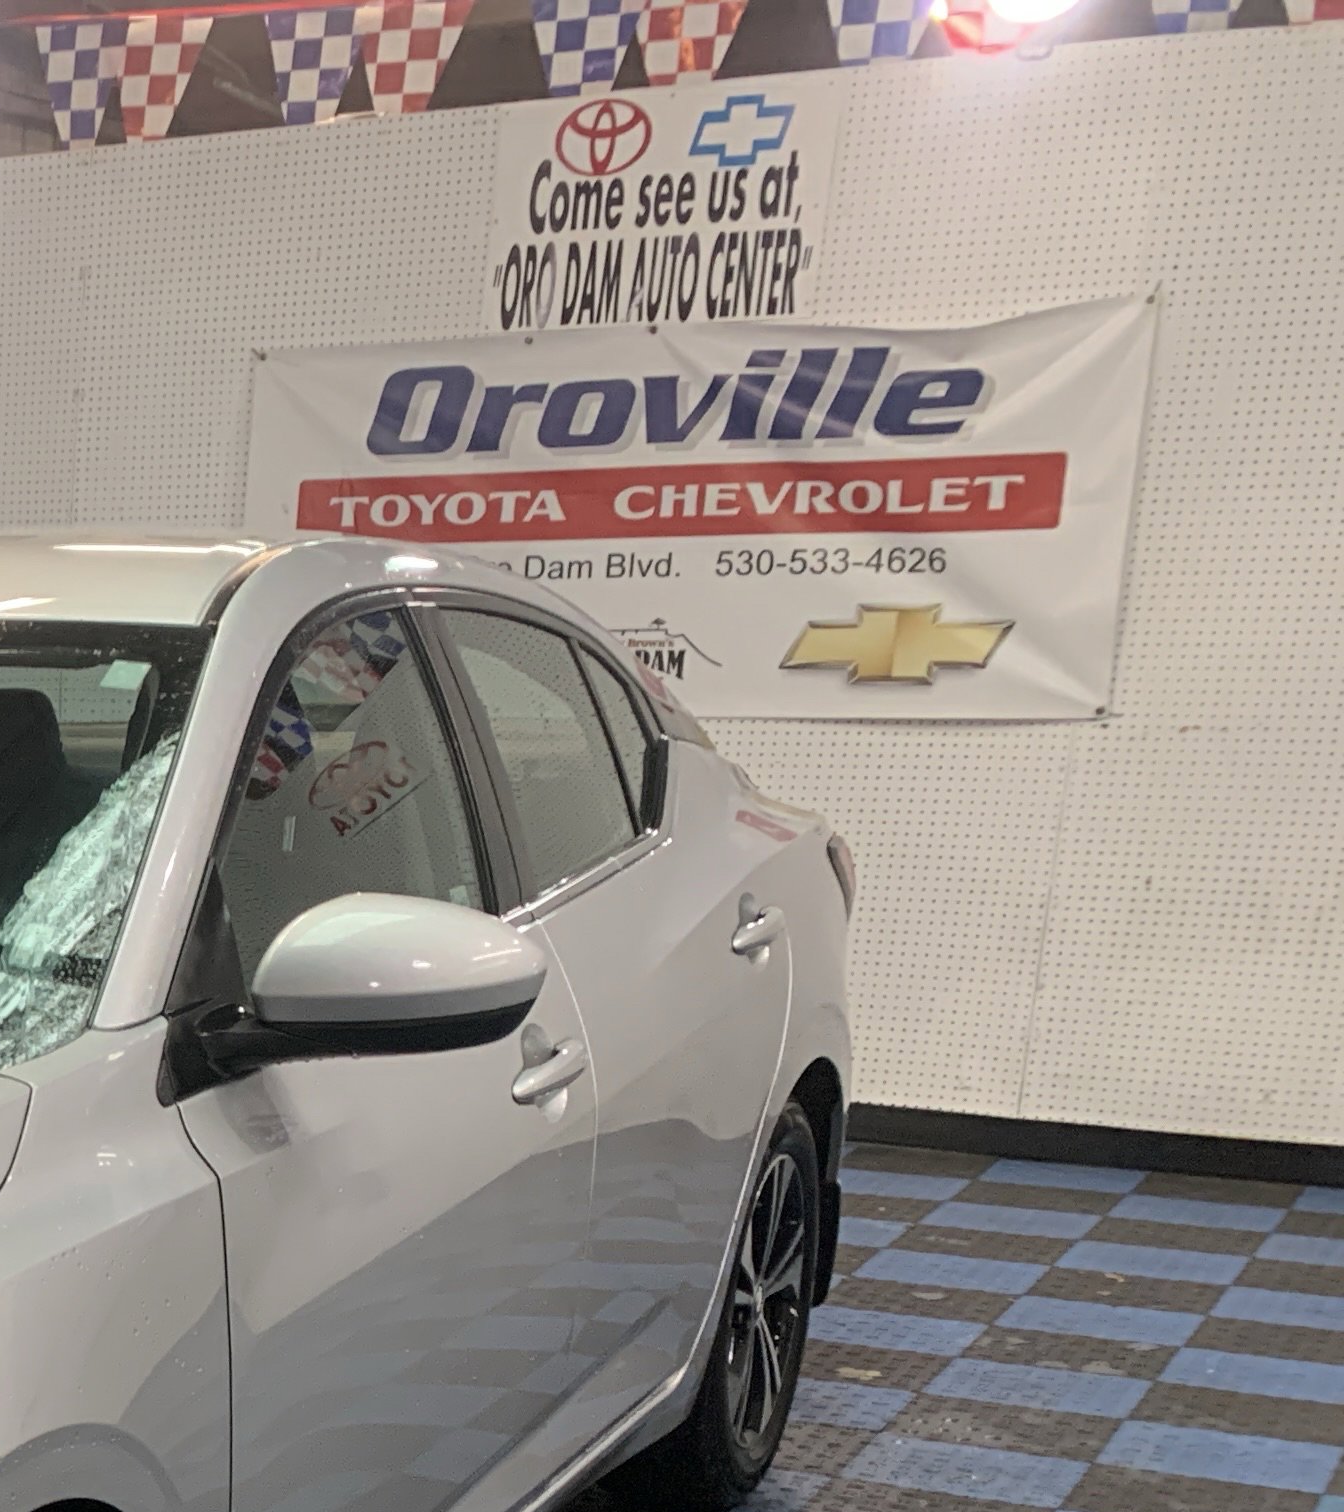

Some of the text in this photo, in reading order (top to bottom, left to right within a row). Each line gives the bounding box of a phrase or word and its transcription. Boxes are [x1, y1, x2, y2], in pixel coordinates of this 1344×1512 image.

[529, 150, 802, 235] Come see us at,
[560, 239, 624, 326] DAM
[626, 232, 700, 323] AUTO
[706, 227, 814, 320] CENTER"
[367, 346, 990, 458] Oroville
[330, 474, 1026, 528] TOYOTA CHEVROLET
[524, 554, 593, 579] Dam
[606, 552, 681, 578] Blvd.
[715, 546, 947, 577] 530-533-4626
